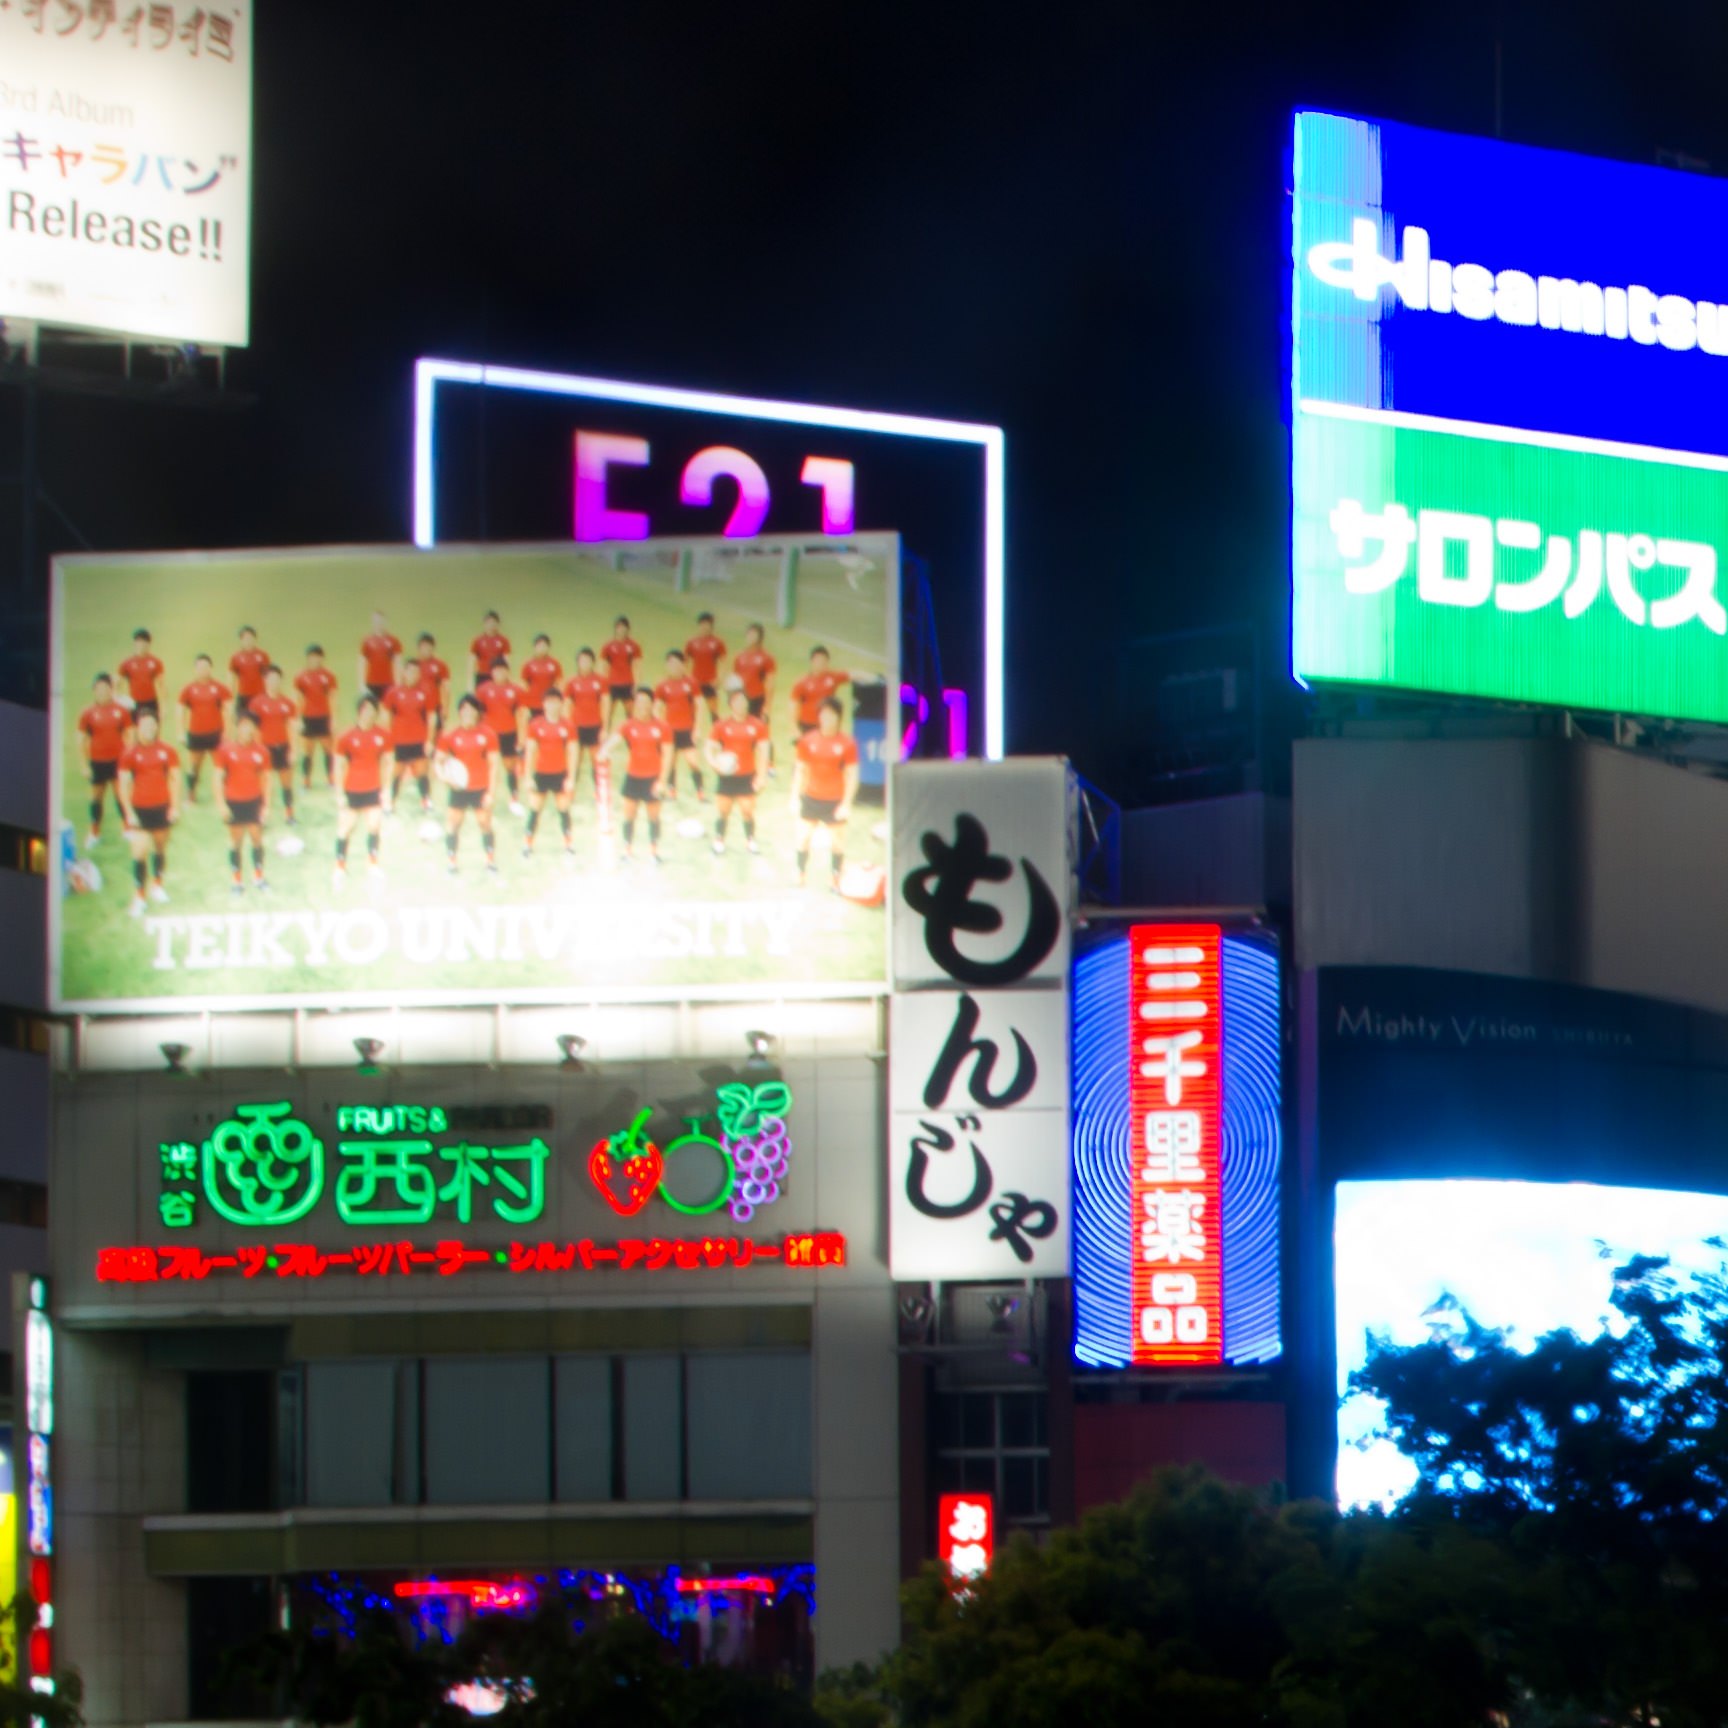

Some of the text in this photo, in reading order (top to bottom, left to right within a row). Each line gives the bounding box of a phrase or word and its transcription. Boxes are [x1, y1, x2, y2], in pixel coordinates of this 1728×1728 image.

[48, 90, 134, 128] Album
[8, 190, 223, 262] Release!!
[1330, 497, 1727, 635] サロンパス
[146, 900, 796, 970] TEIKYO UNIVSITY
[903, 813, 1061, 1264] もんじゃ
[1337, 1003, 1442, 1042] Mighty
[1451, 1015, 1537, 1048] Vision
[159, 1141, 198, 1227] 渋谷
[335, 1136, 551, 1225] 西村
[1139, 945, 1208, 1345] 三千里薬品
